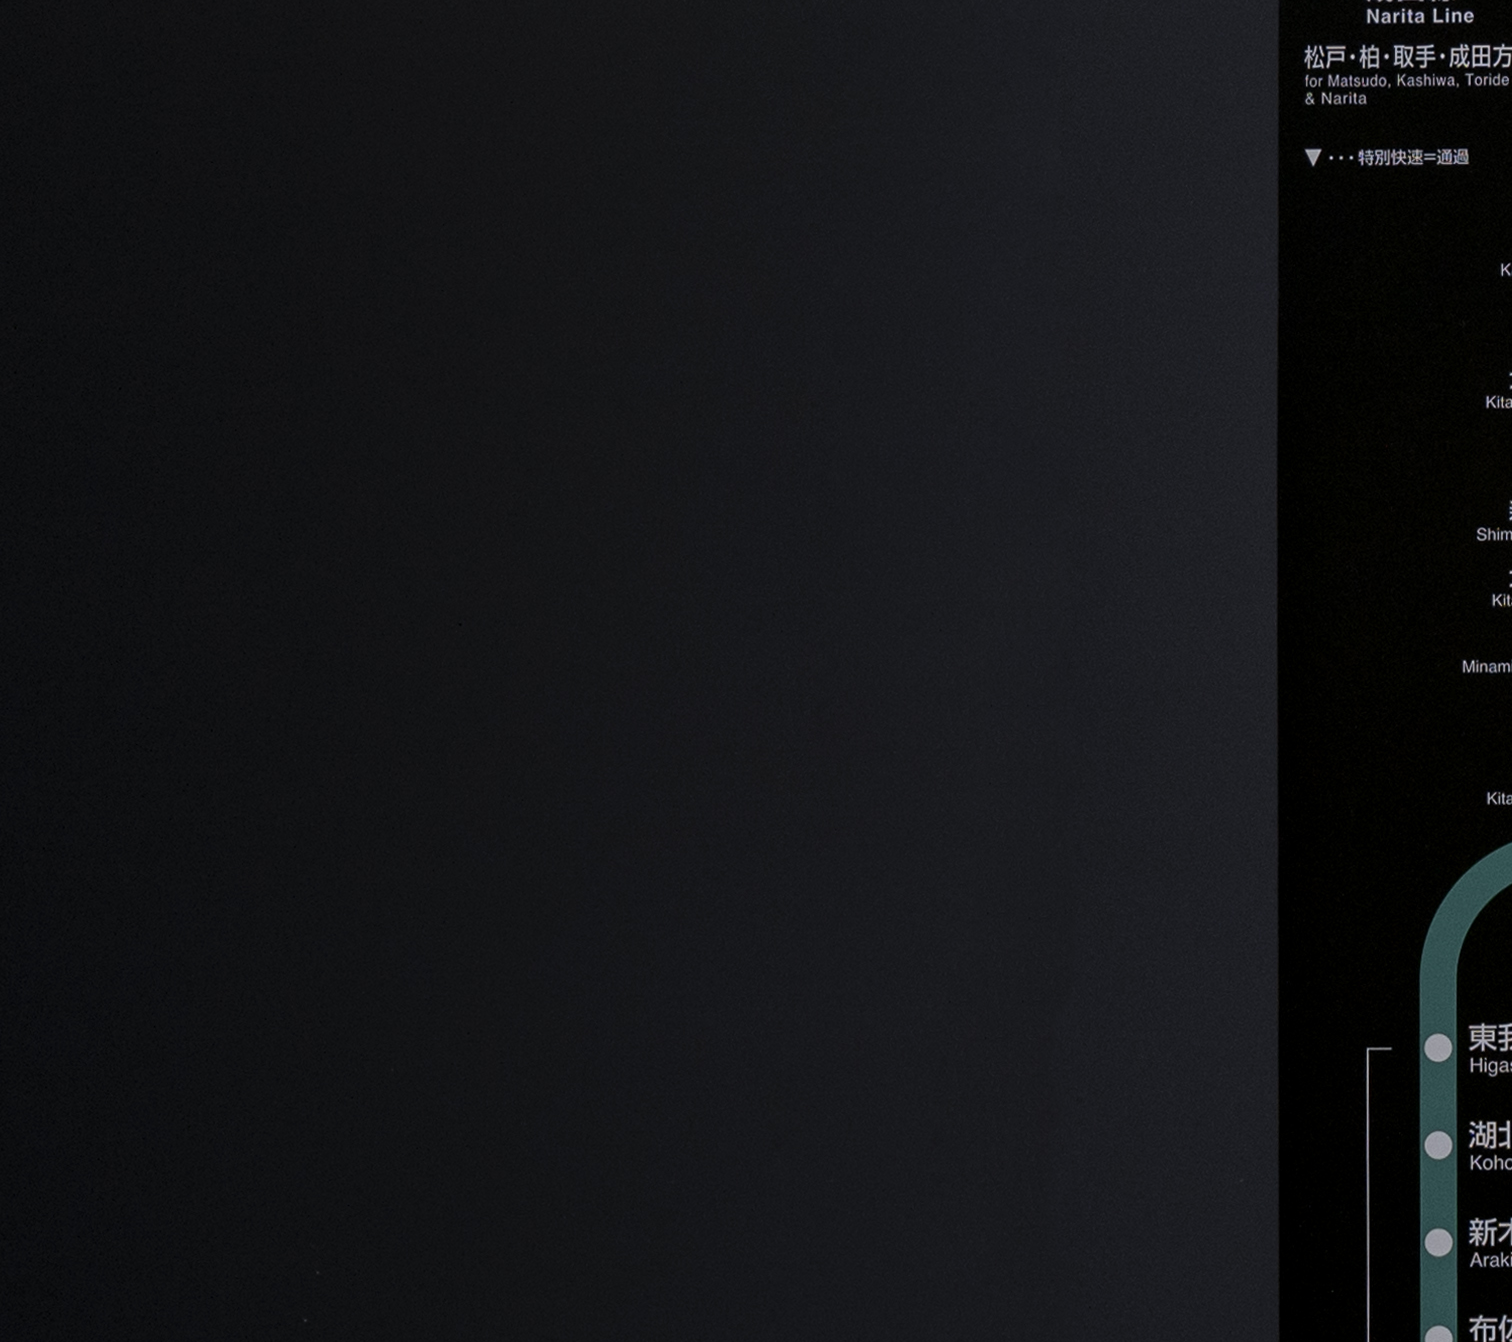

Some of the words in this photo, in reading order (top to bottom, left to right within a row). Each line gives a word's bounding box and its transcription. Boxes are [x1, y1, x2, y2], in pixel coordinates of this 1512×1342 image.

[1367, 8, 1424, 24] Narita
[1433, 8, 1474, 23] Line
[1305, 75, 1323, 87] for
[1328, 74, 1391, 88] Matsudo,
[1397, 74, 1459, 87] Kashiwa,
[1465, 73, 1509, 86] Toride
[1305, 92, 1315, 105] &
[1322, 92, 1367, 105] Narita
[1470, 1252, 1512, 1267] Araki
